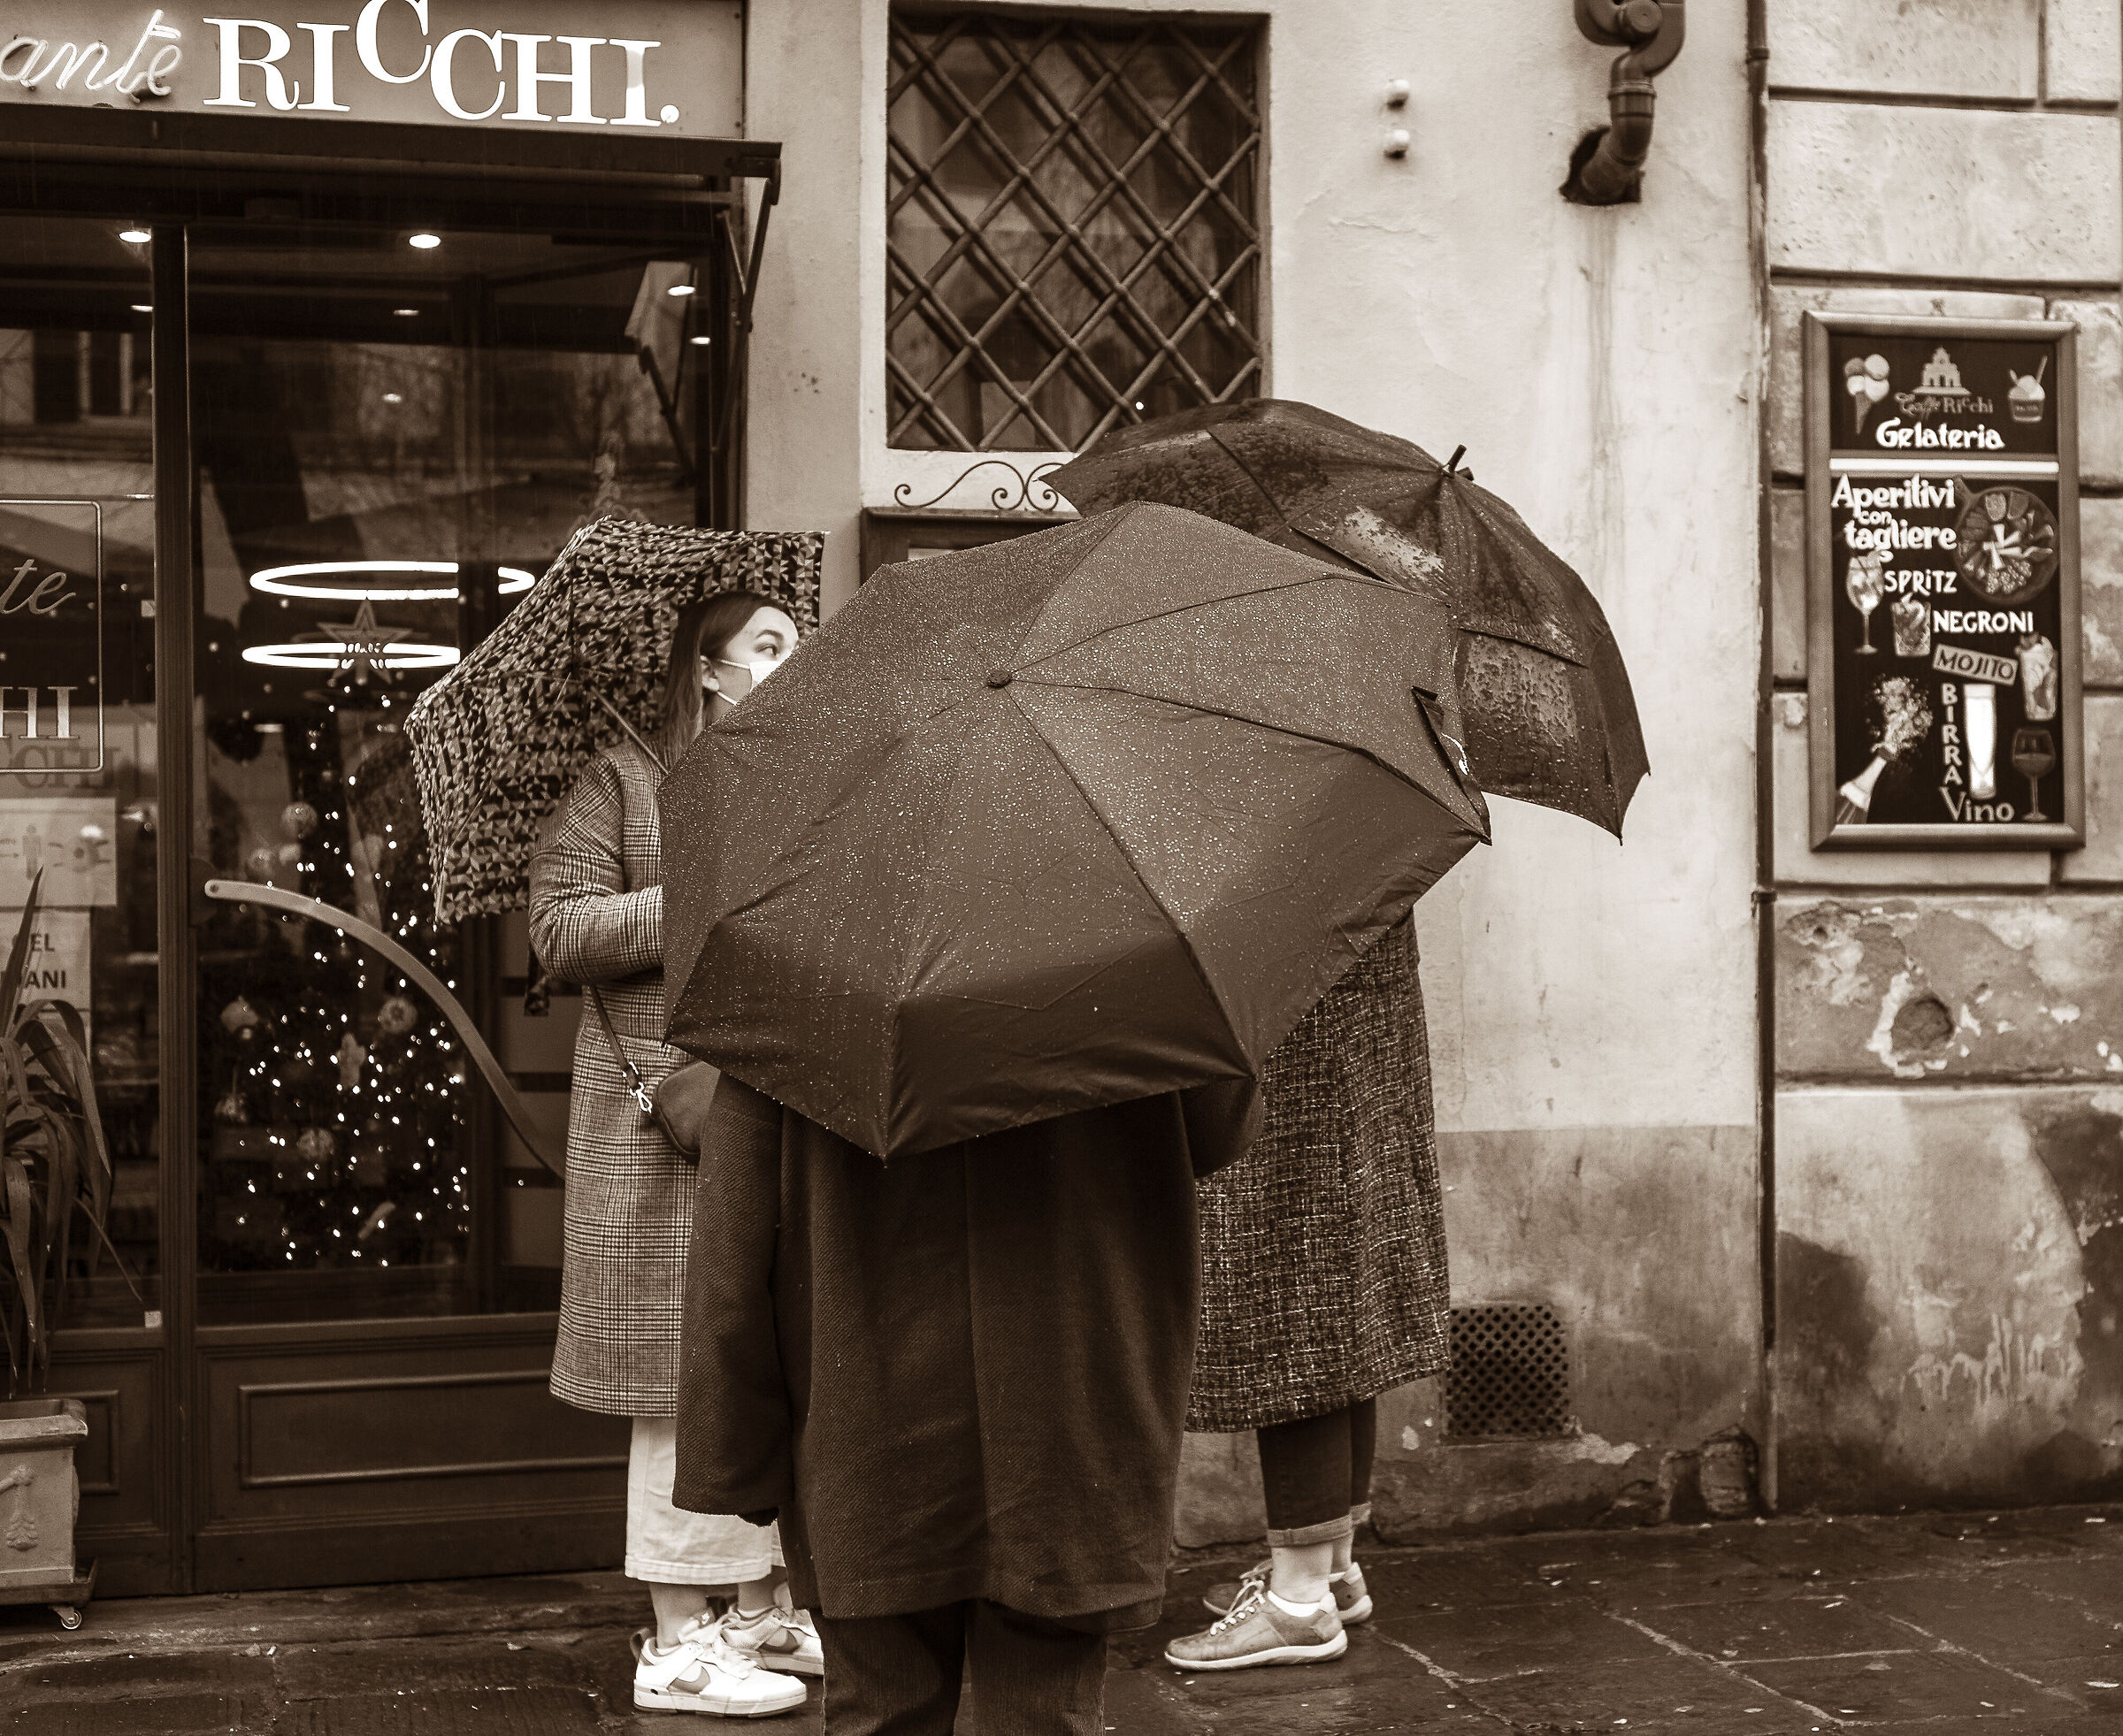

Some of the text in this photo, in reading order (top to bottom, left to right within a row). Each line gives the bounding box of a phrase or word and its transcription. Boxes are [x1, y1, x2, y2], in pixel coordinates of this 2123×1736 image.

[1876, 417, 2005, 450] Gelateria
[1831, 473, 1956, 518] Aperitivi
[1859, 510, 1893, 525] con
[1843, 520, 1958, 562] tagliere
[1933, 610, 2034, 633] NEGRONI
[1937, 649, 2014, 680] MOJITO
[1941, 683, 1963, 785] BIRRA
[1939, 786, 2015, 822] Vino
